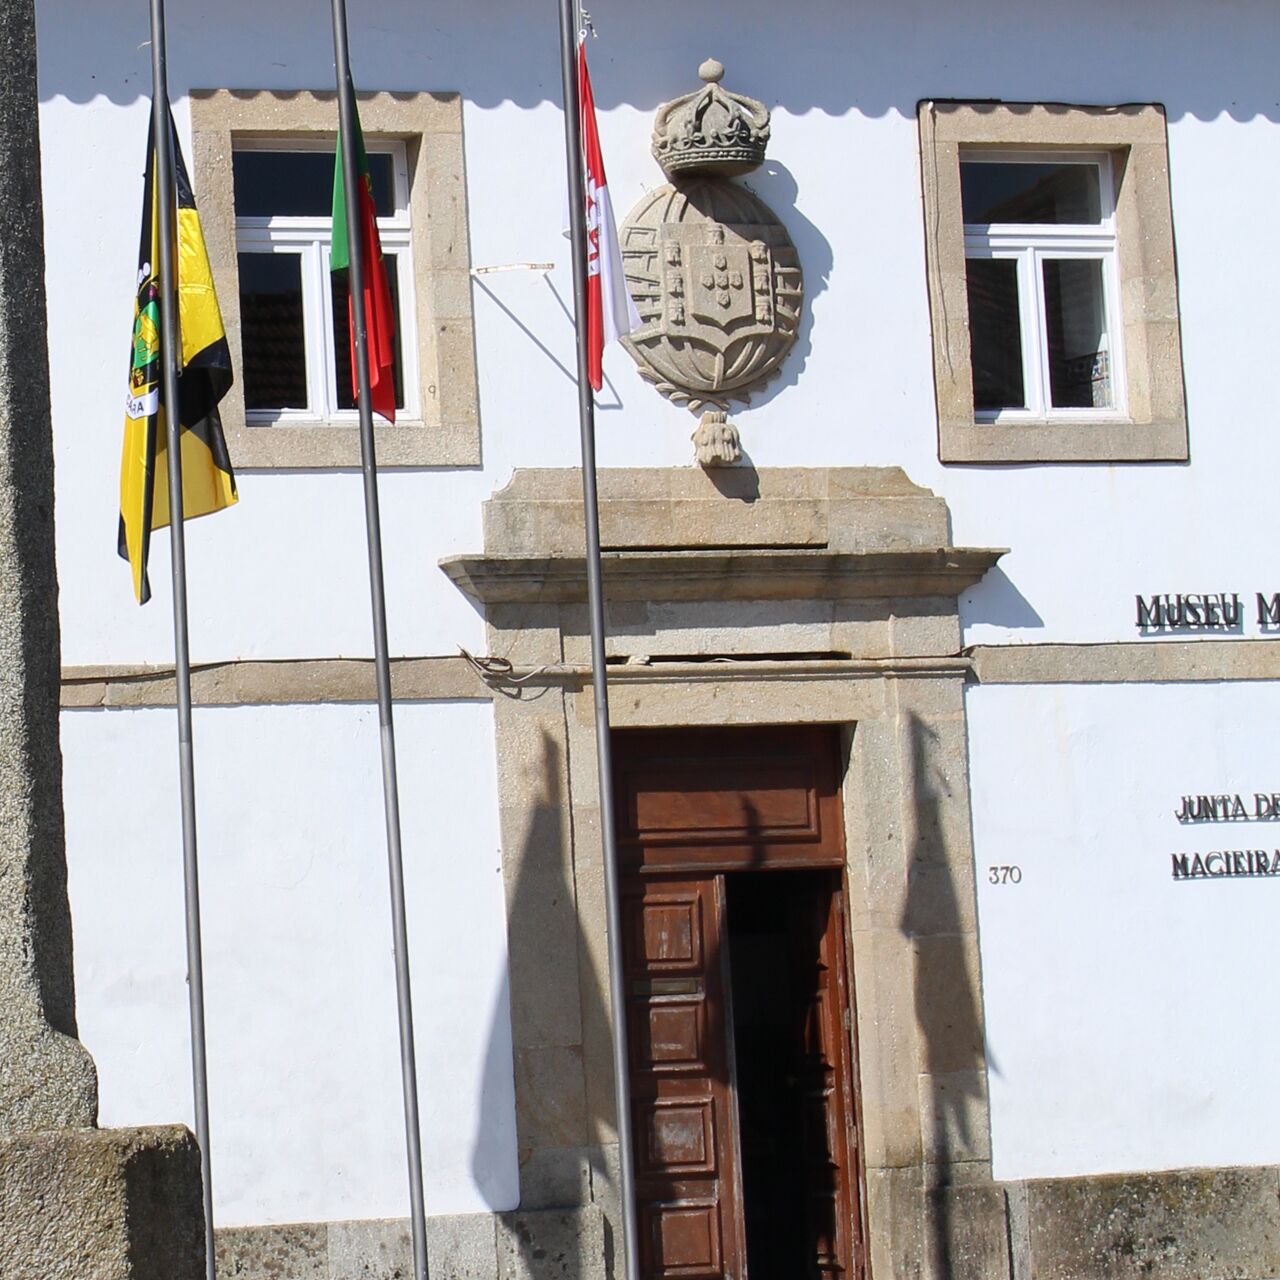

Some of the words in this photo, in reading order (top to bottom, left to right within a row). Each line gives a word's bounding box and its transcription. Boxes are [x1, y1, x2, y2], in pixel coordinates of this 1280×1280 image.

[1135, 592, 1240, 627] MUSEU
[1174, 793, 1249, 820] JUNTA
[988, 865, 1022, 885] 370
